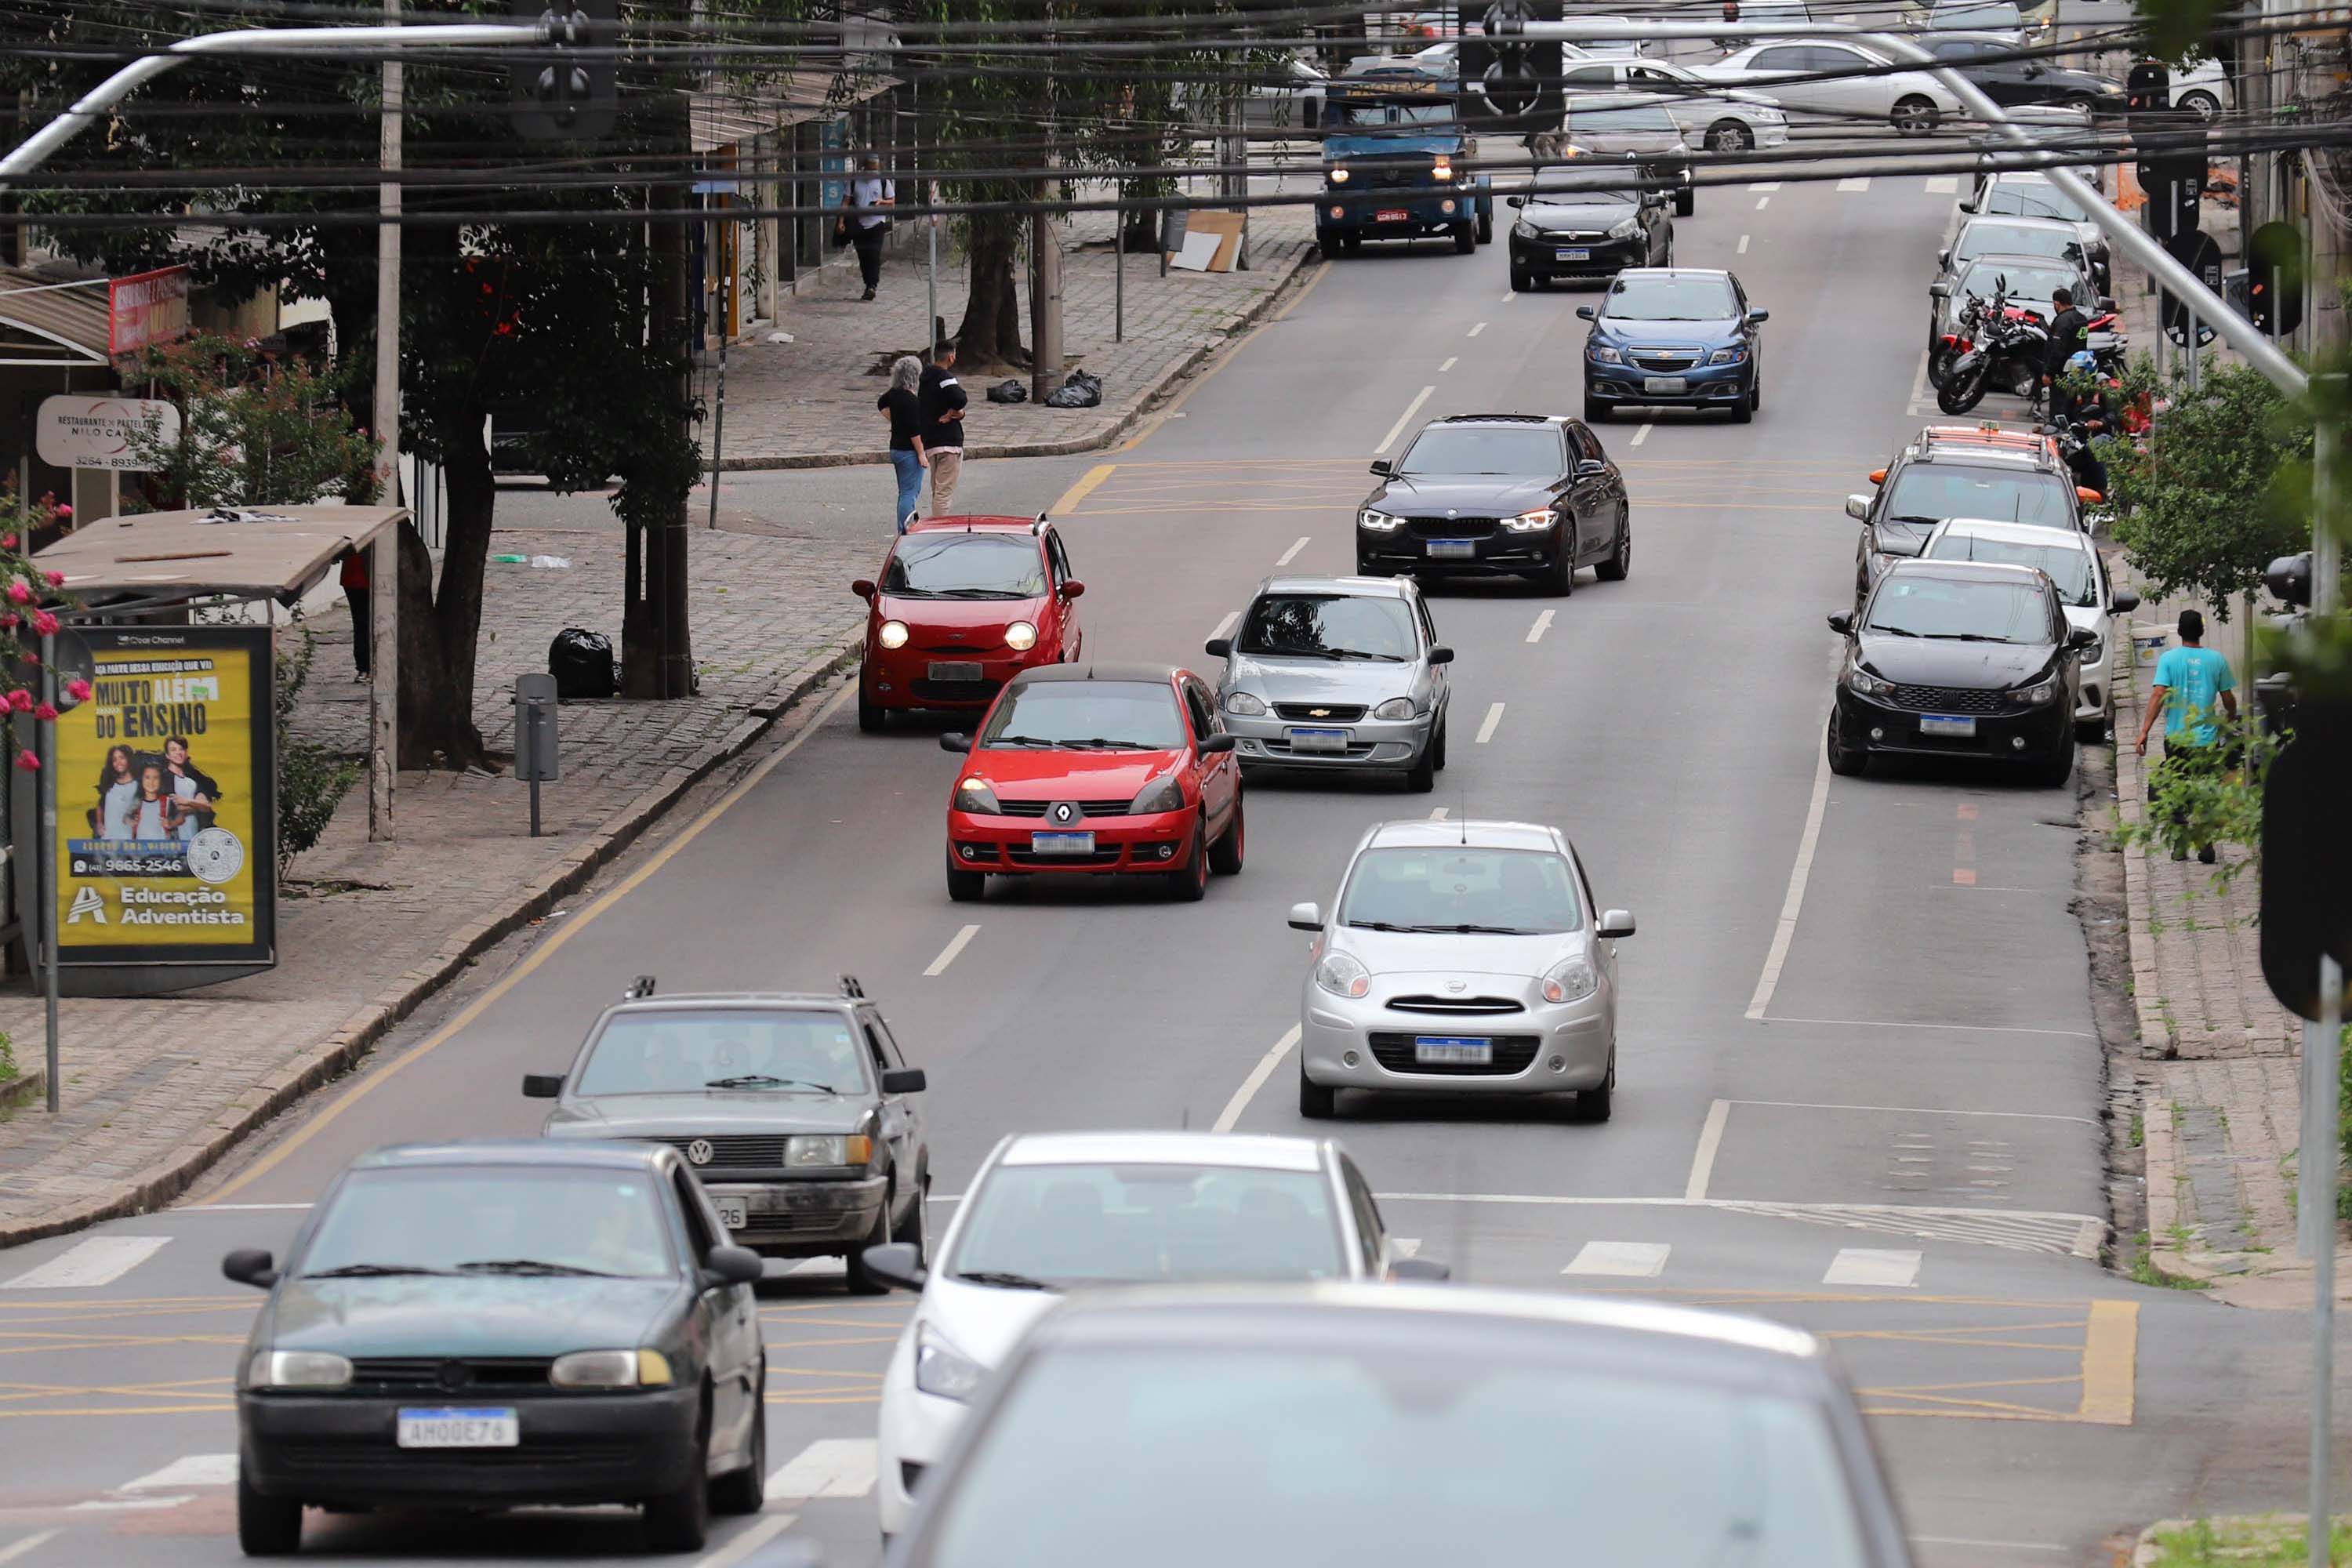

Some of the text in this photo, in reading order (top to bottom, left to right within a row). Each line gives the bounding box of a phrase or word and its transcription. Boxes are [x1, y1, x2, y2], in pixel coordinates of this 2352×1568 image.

[71, 427, 100, 437] NILO
[151, 636, 184, 644] Channel
[96, 681, 151, 706] MUITO
[96, 702, 206, 739] DO ENSINO
[106, 860, 182, 872] 9665-2546
[120, 887, 226, 906] Educação
[121, 908, 245, 924] Adventista
